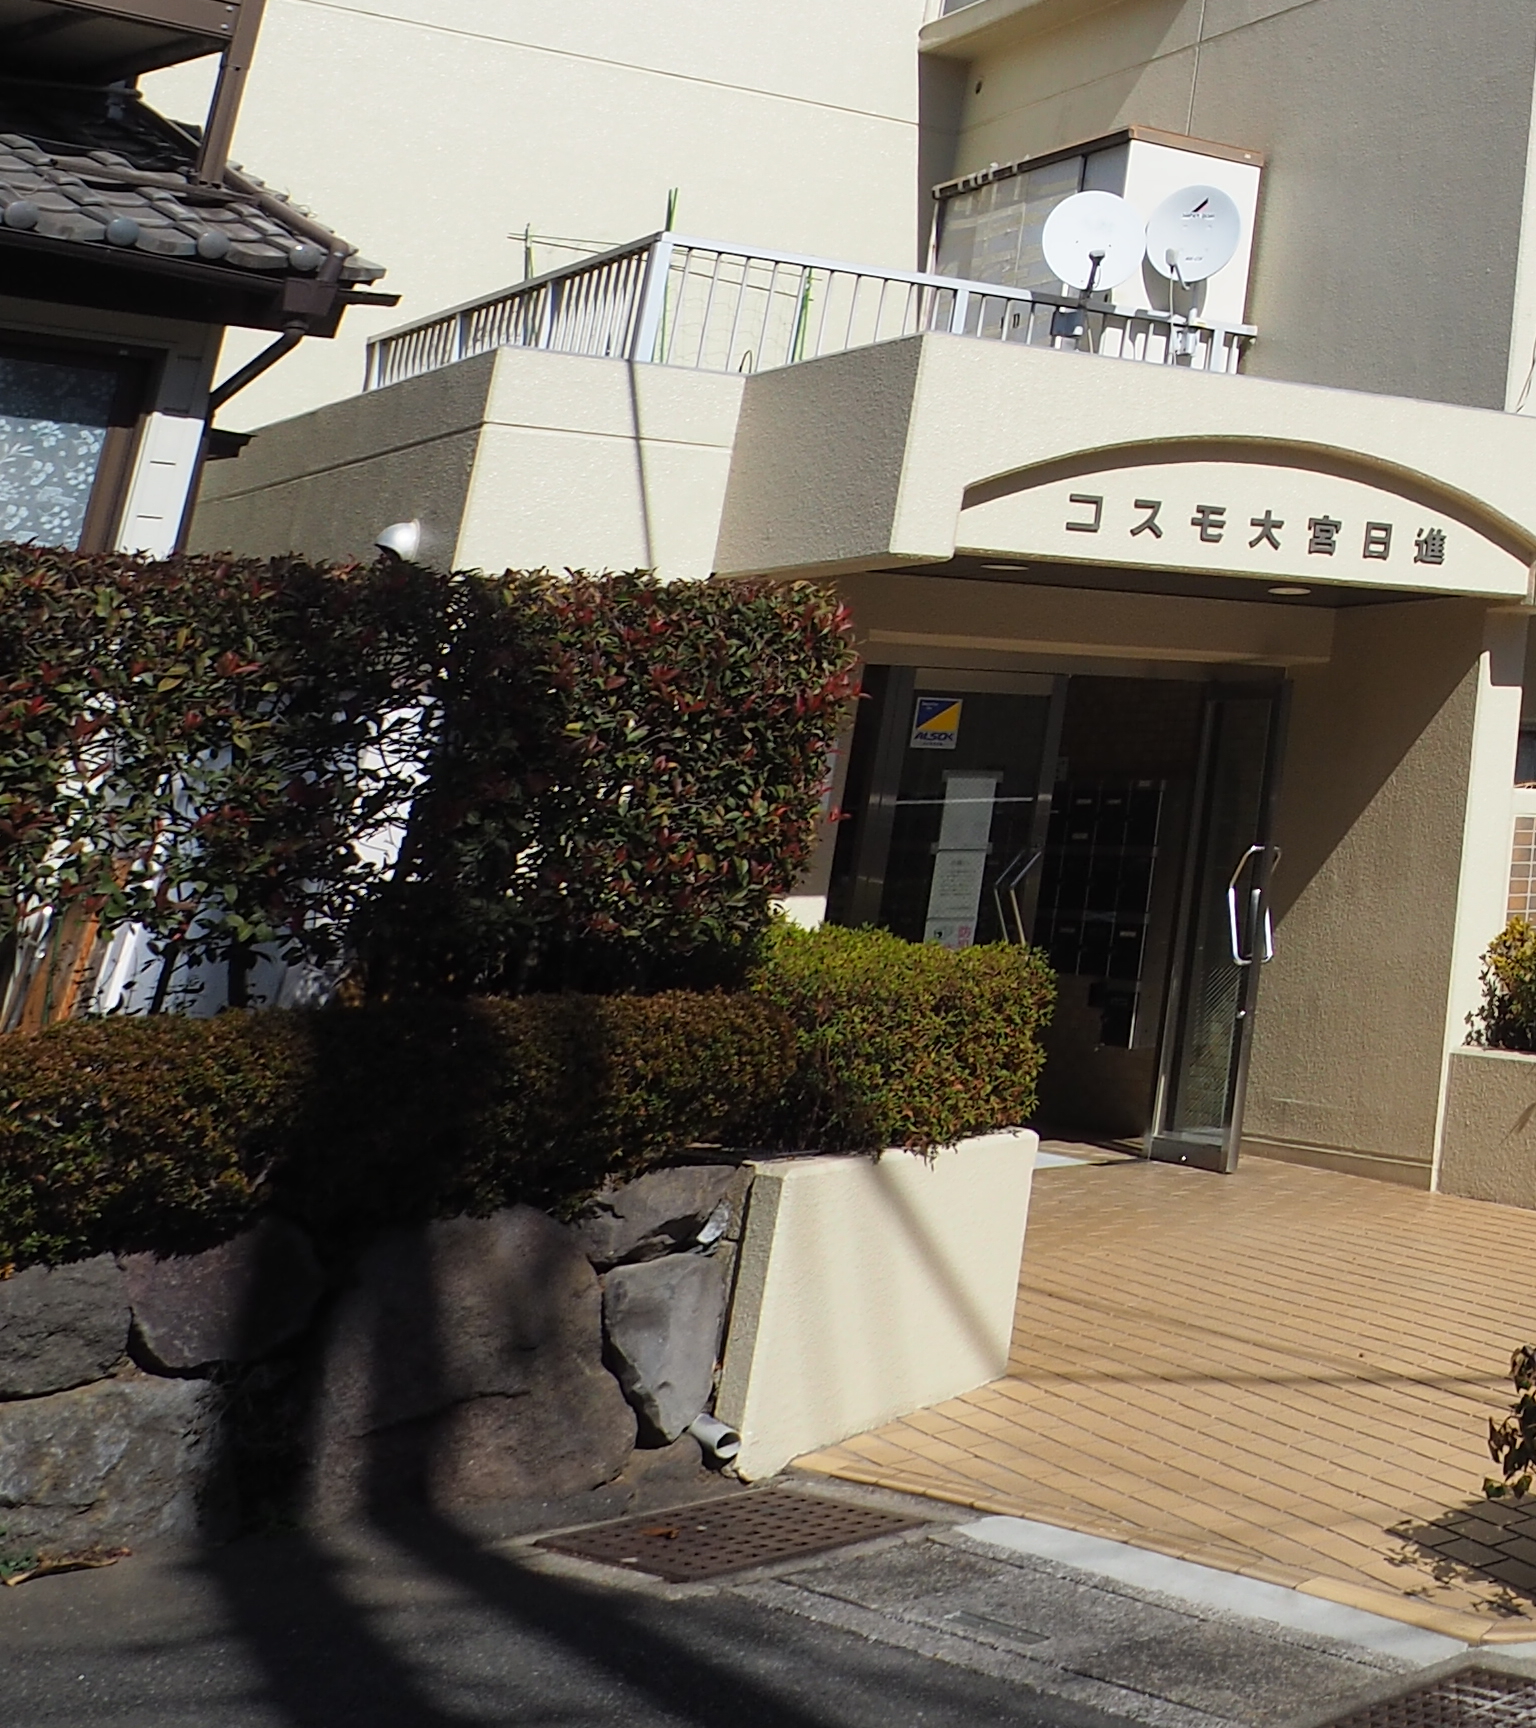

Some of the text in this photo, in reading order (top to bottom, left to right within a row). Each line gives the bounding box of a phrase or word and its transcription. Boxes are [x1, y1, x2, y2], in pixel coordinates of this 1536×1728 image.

[1066, 494, 1447, 565] コスモ大宮日進
[914, 732, 953, 741] ALSOK
